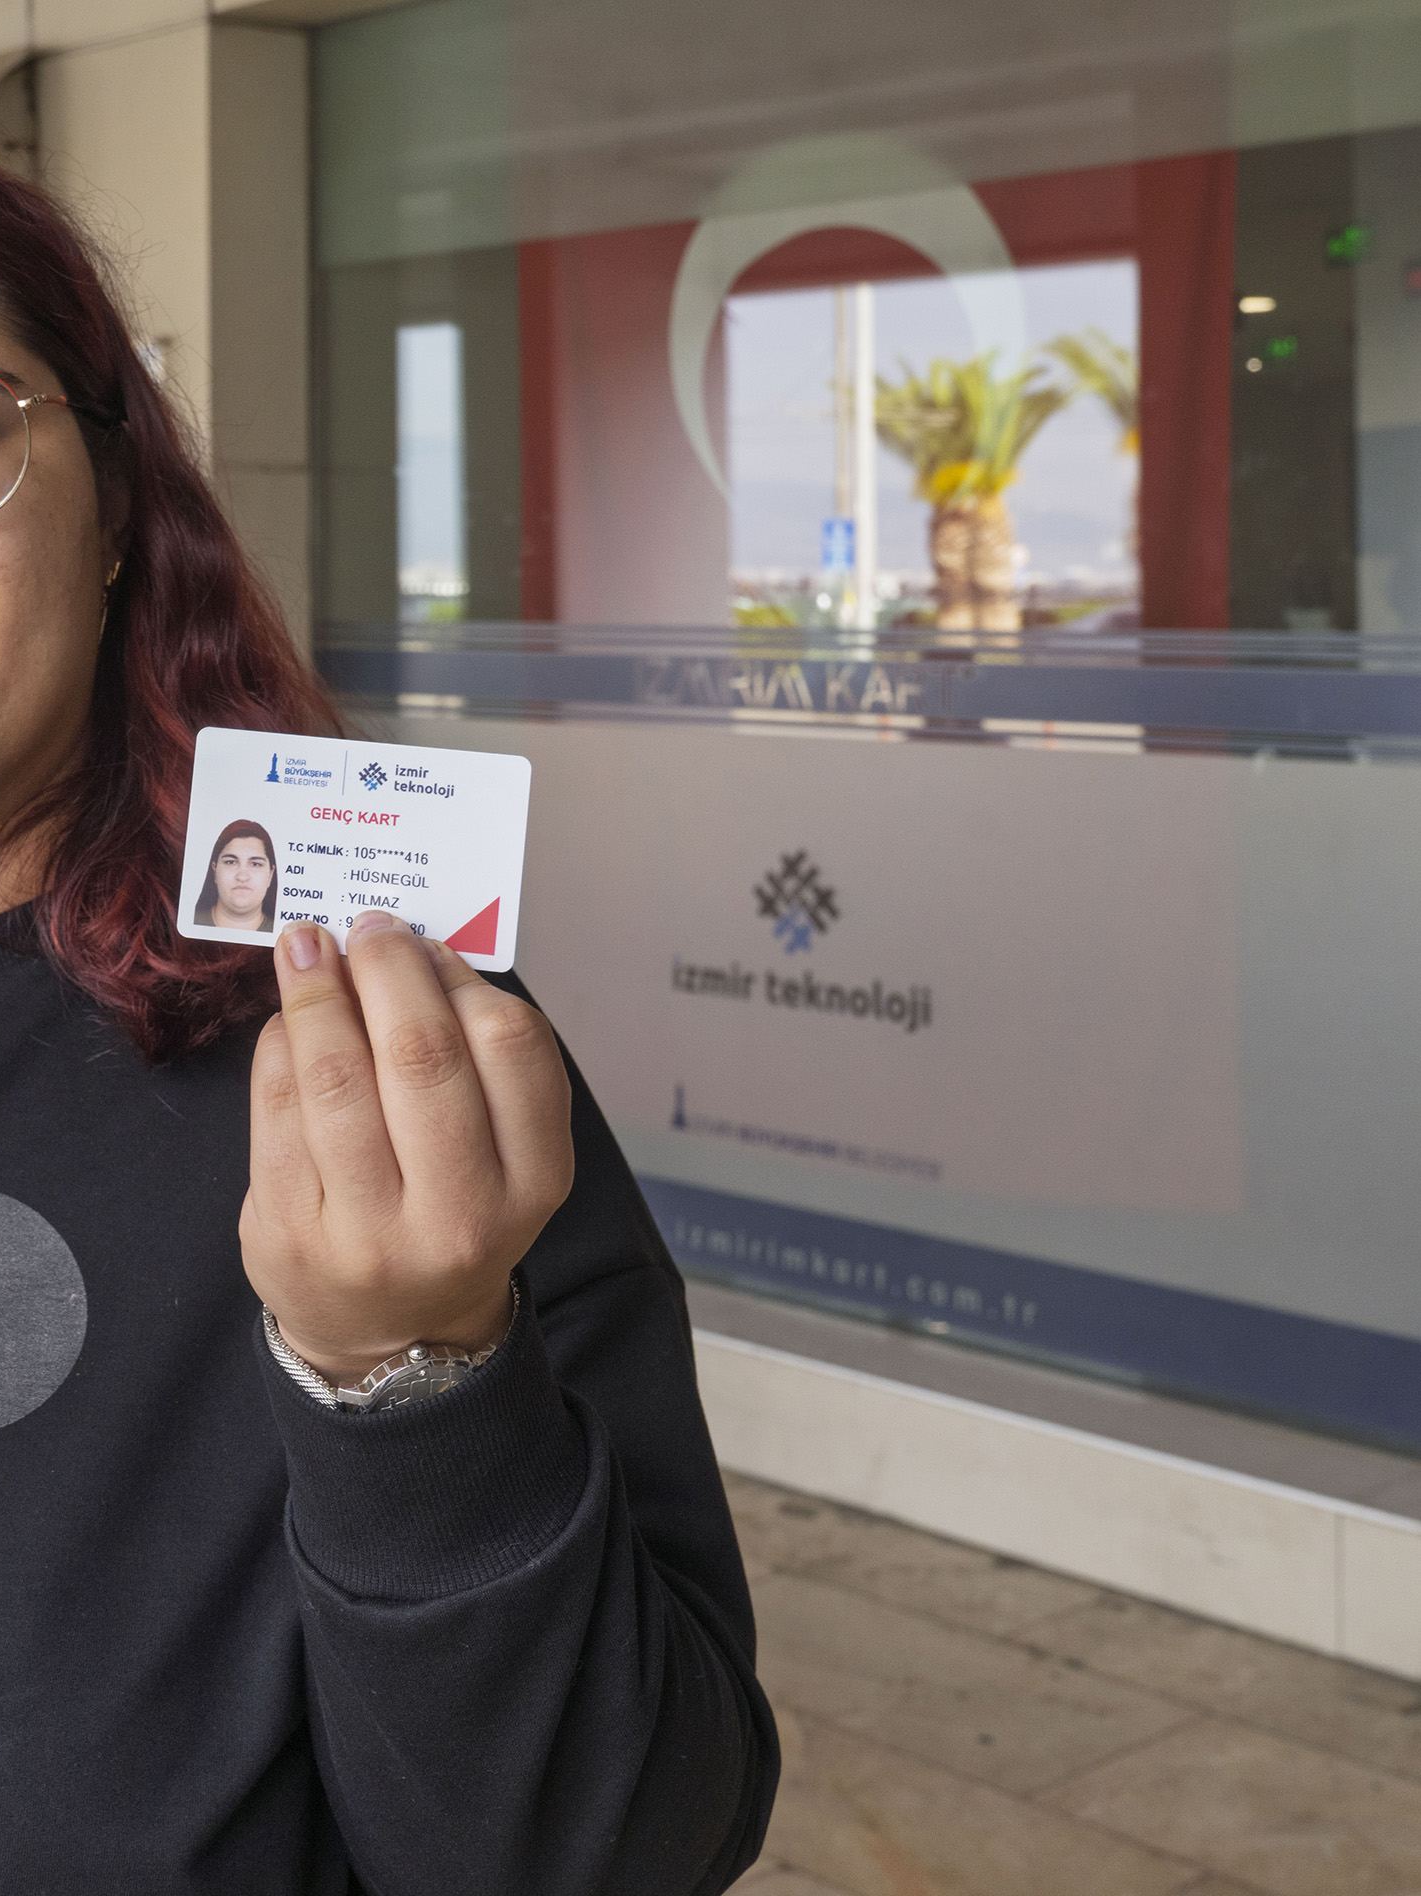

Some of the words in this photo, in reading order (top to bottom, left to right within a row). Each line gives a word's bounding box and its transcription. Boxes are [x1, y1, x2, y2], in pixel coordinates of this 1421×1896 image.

[284, 767, 332, 779] BÜYÜKŞEHİR
[395, 765, 429, 779] izmir
[394, 781, 455, 799] teknoloji
[310, 807, 353, 825] GENÇ
[358, 811, 400, 826] KART
[288, 842, 304, 852] T.C
[306, 843, 344, 857] KİMLİK
[285, 865, 305, 875] ADI
[350, 868, 430, 888] HÜSNEGÜL
[282, 887, 323, 900] SOYADI
[348, 892, 400, 909] YILMAZ
[280, 911, 310, 921] KART
[313, 914, 329, 925] NO
[672, 955, 756, 1000] izmir
[765, 968, 933, 1034] teknoloji
